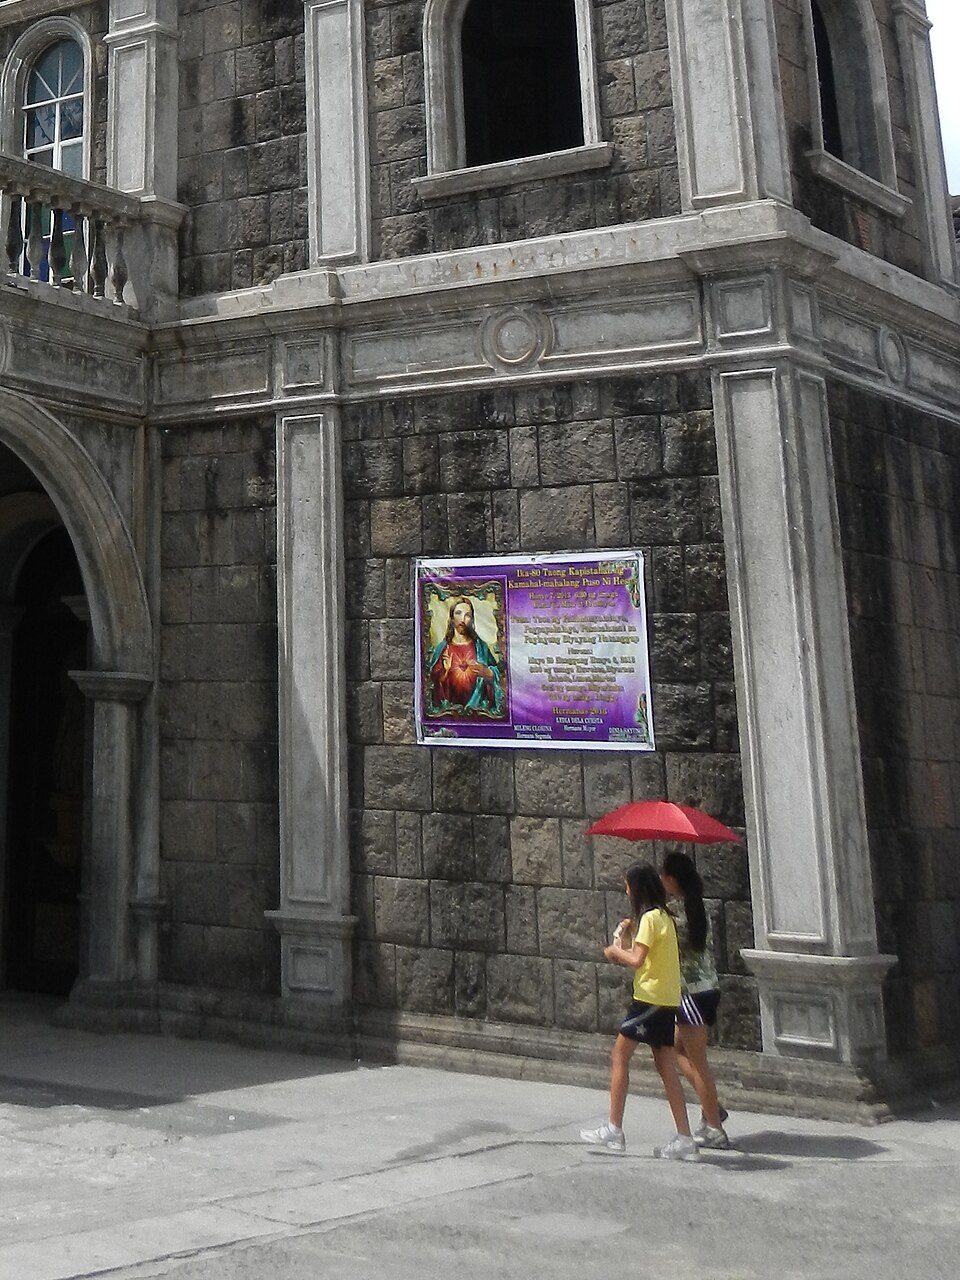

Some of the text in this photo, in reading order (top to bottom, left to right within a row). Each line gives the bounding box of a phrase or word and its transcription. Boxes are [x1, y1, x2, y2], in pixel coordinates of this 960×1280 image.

[543, 568, 566, 578] Taong
[582, 578, 600, 587] Puso
[602, 577, 611, 586] Ni
